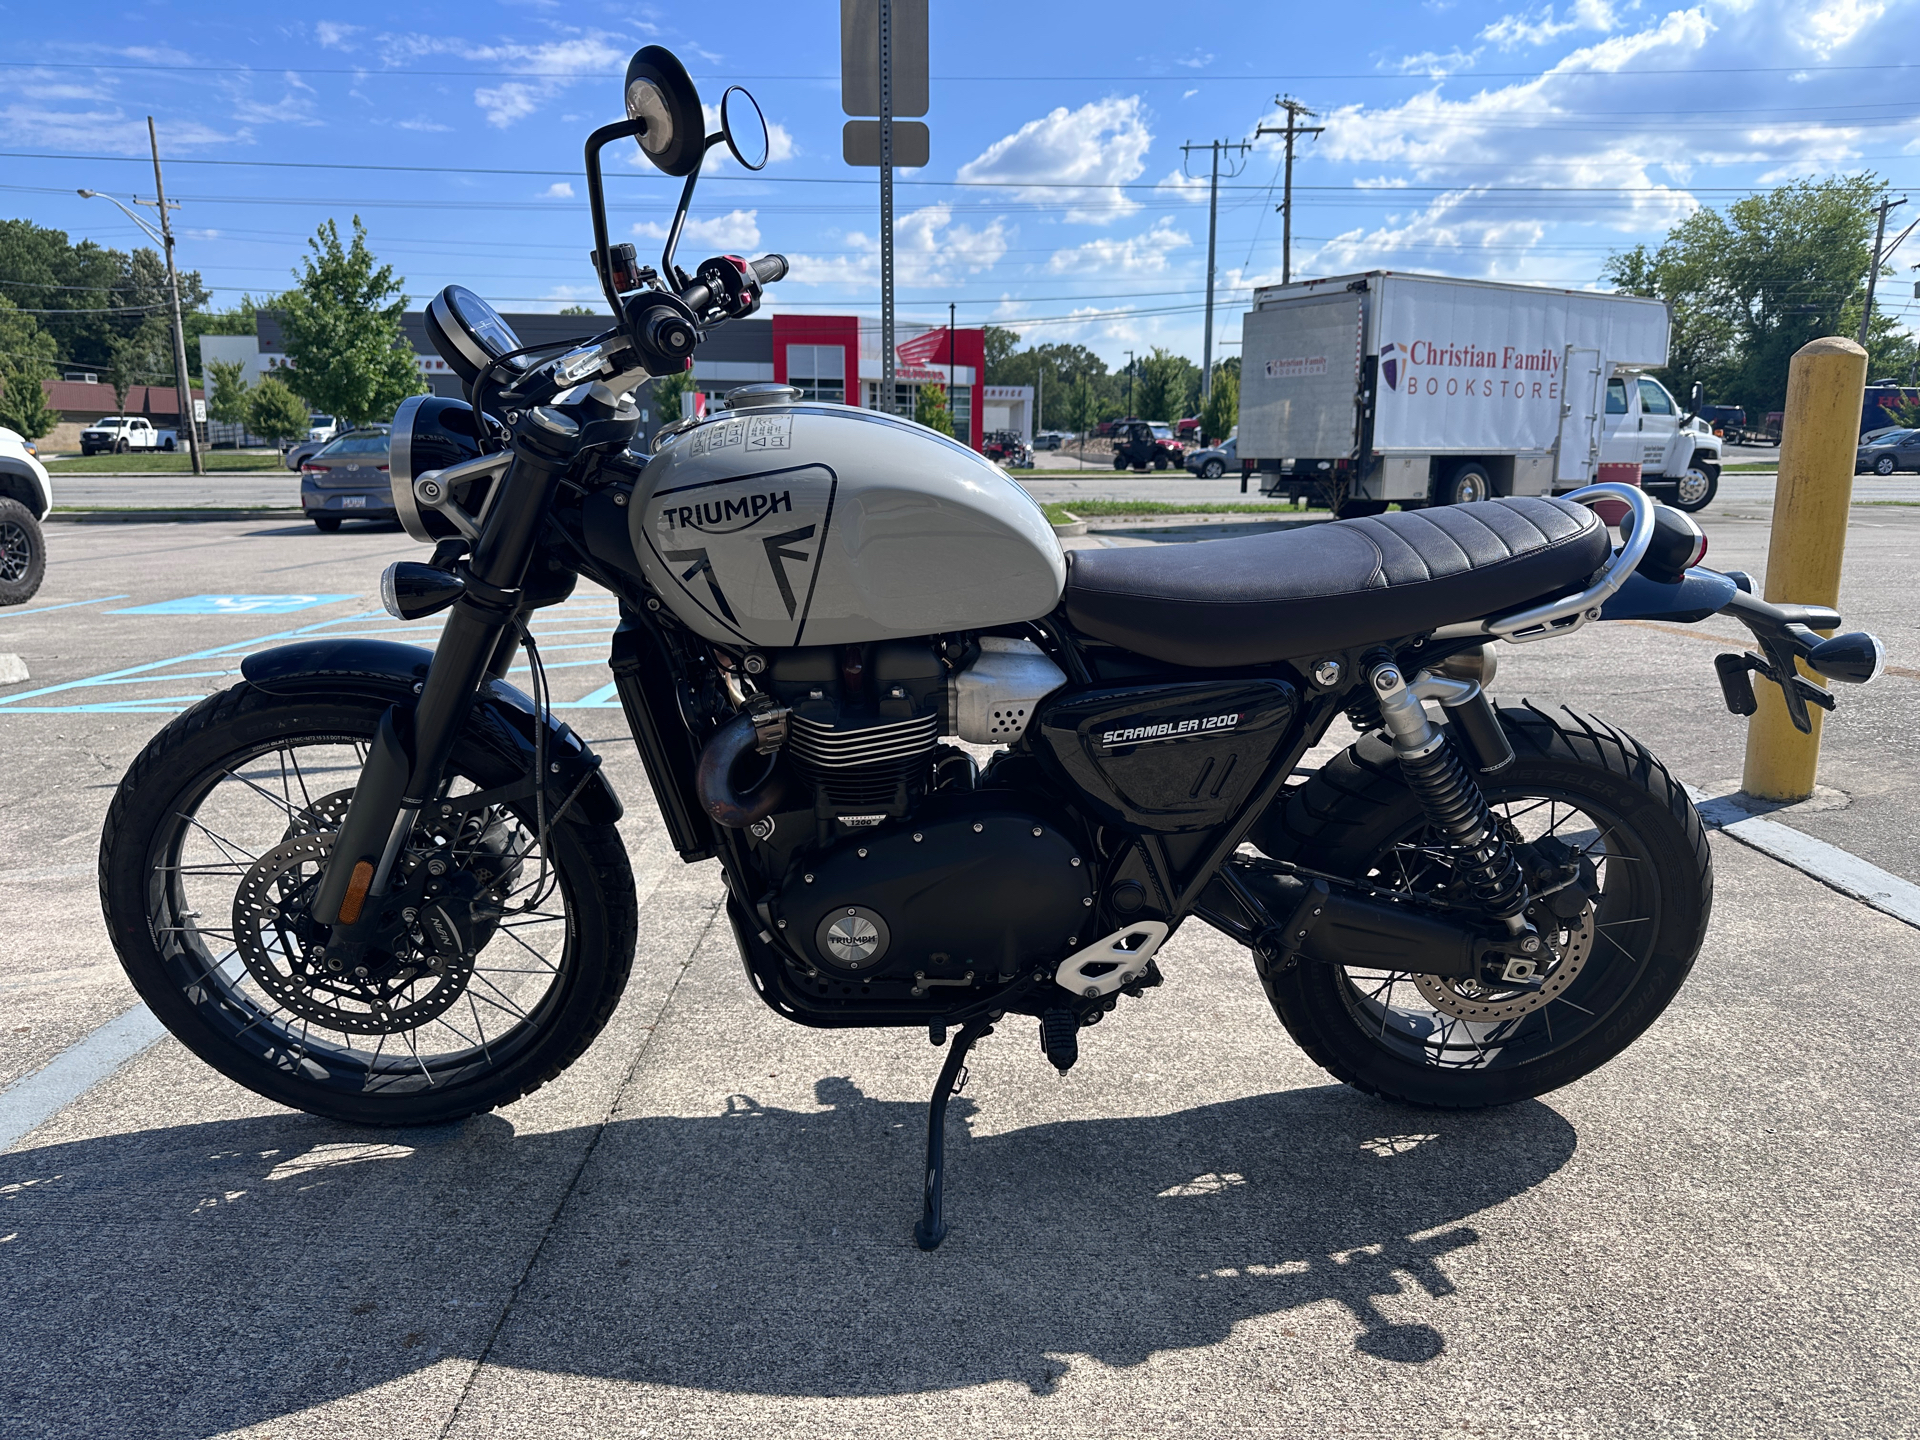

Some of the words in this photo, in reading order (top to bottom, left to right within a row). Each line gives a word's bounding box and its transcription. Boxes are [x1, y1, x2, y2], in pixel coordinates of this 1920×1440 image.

[1274, 358, 1303, 368] Christian
[1304, 356, 1326, 366] Family
[1410, 340, 1496, 368] Christian
[1502, 346, 1562, 378] Family
[896, 368, 945, 380] HONDA
[1274, 366, 1326, 376] BOOKSTORE
[984, 388, 1022, 397] ERVICE
[1408, 376, 1558, 399] BOOKSTORE
[662, 490, 793, 534] TRIUMPH
[1102, 719, 1199, 743] SCRAMBLER
[1500, 768, 1618, 798] METZELER
[830, 936, 876, 946] TRIUMPH
[1604, 966, 1666, 1043] KAROO
[1518, 1045, 1590, 1084] STREET
